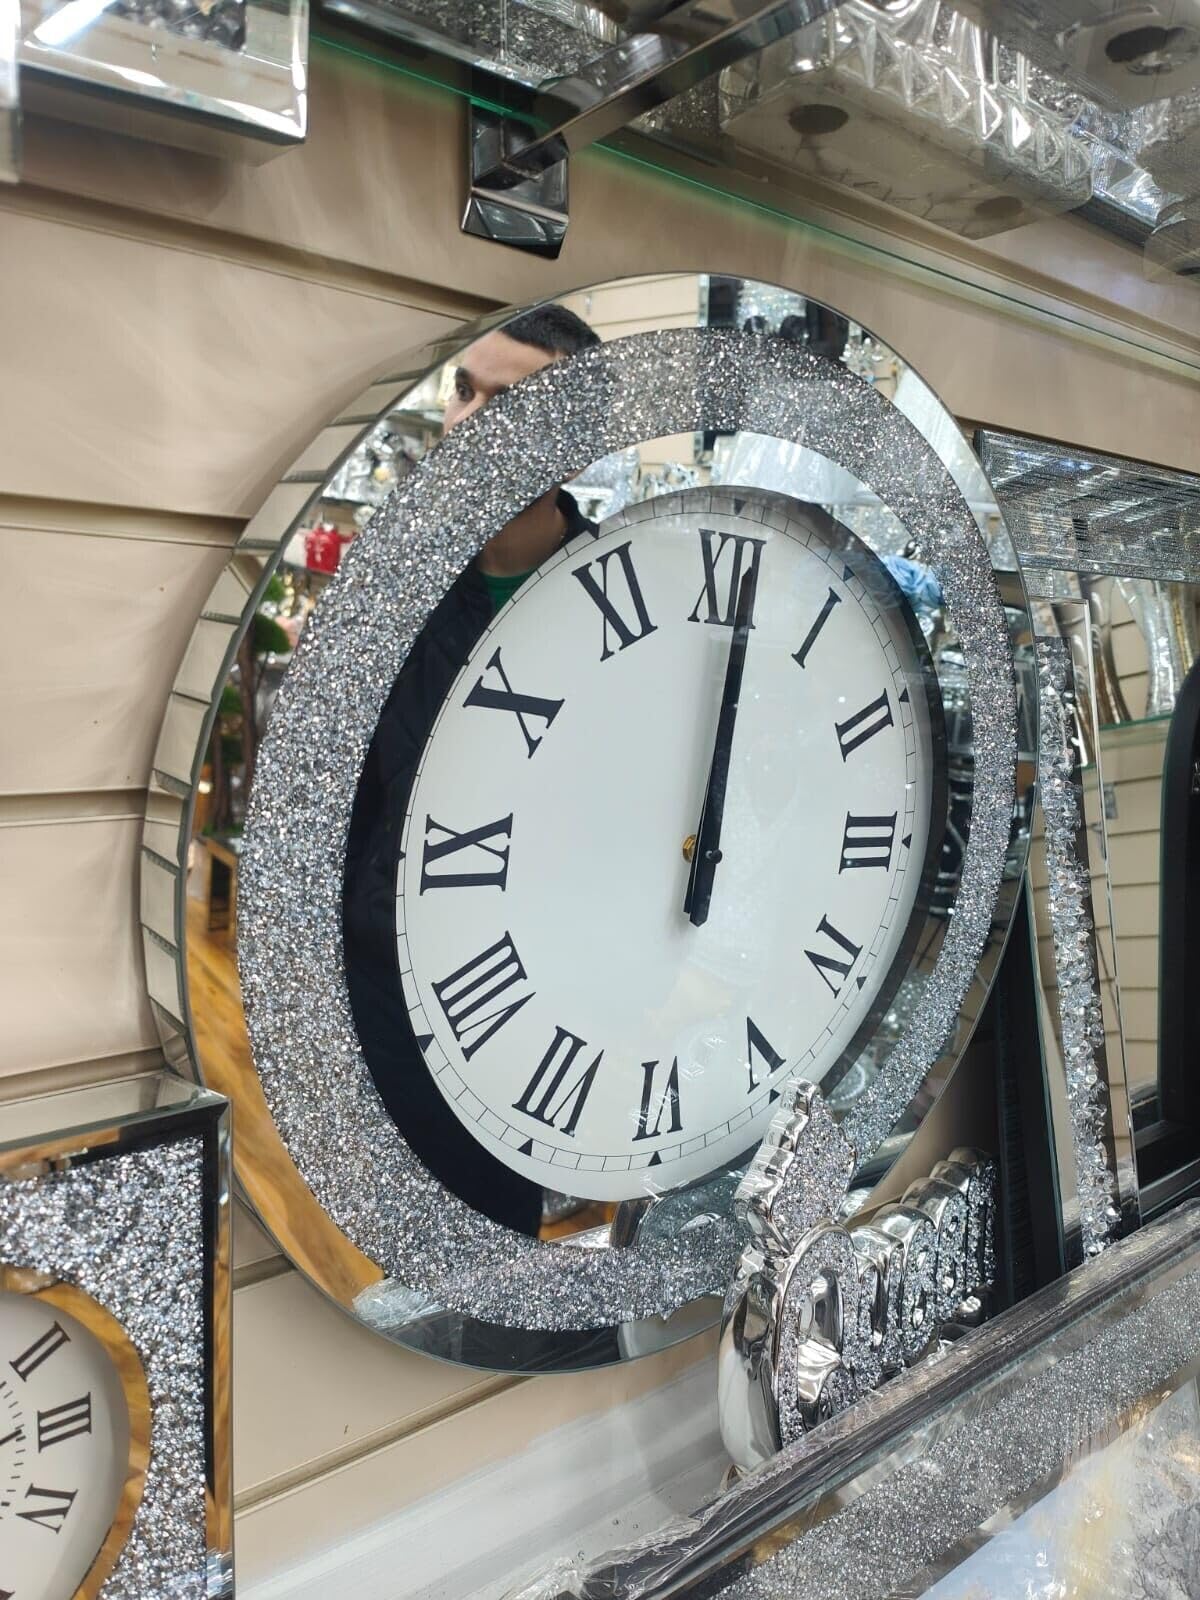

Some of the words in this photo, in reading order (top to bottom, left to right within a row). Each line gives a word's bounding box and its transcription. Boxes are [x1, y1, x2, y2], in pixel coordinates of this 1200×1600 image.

[571, 541, 659, 662] XI
[687, 528, 767, 630] XII
[791, 587, 842, 669] I
[462, 646, 566, 759] X
[834, 688, 894, 763] II
[419, 812, 514, 896] IX
[838, 810, 898, 875] III
[431, 930, 536, 1062] VIII
[803, 913, 863, 999] IV
[511, 1025, 604, 1138] VII
[746, 1016, 787, 1094] V
[632, 1055, 683, 1142] VI
[9, 1320, 71, 1382] II
[37, 1392, 92, 1453] III
[15, 1483, 79, 1534] IV
